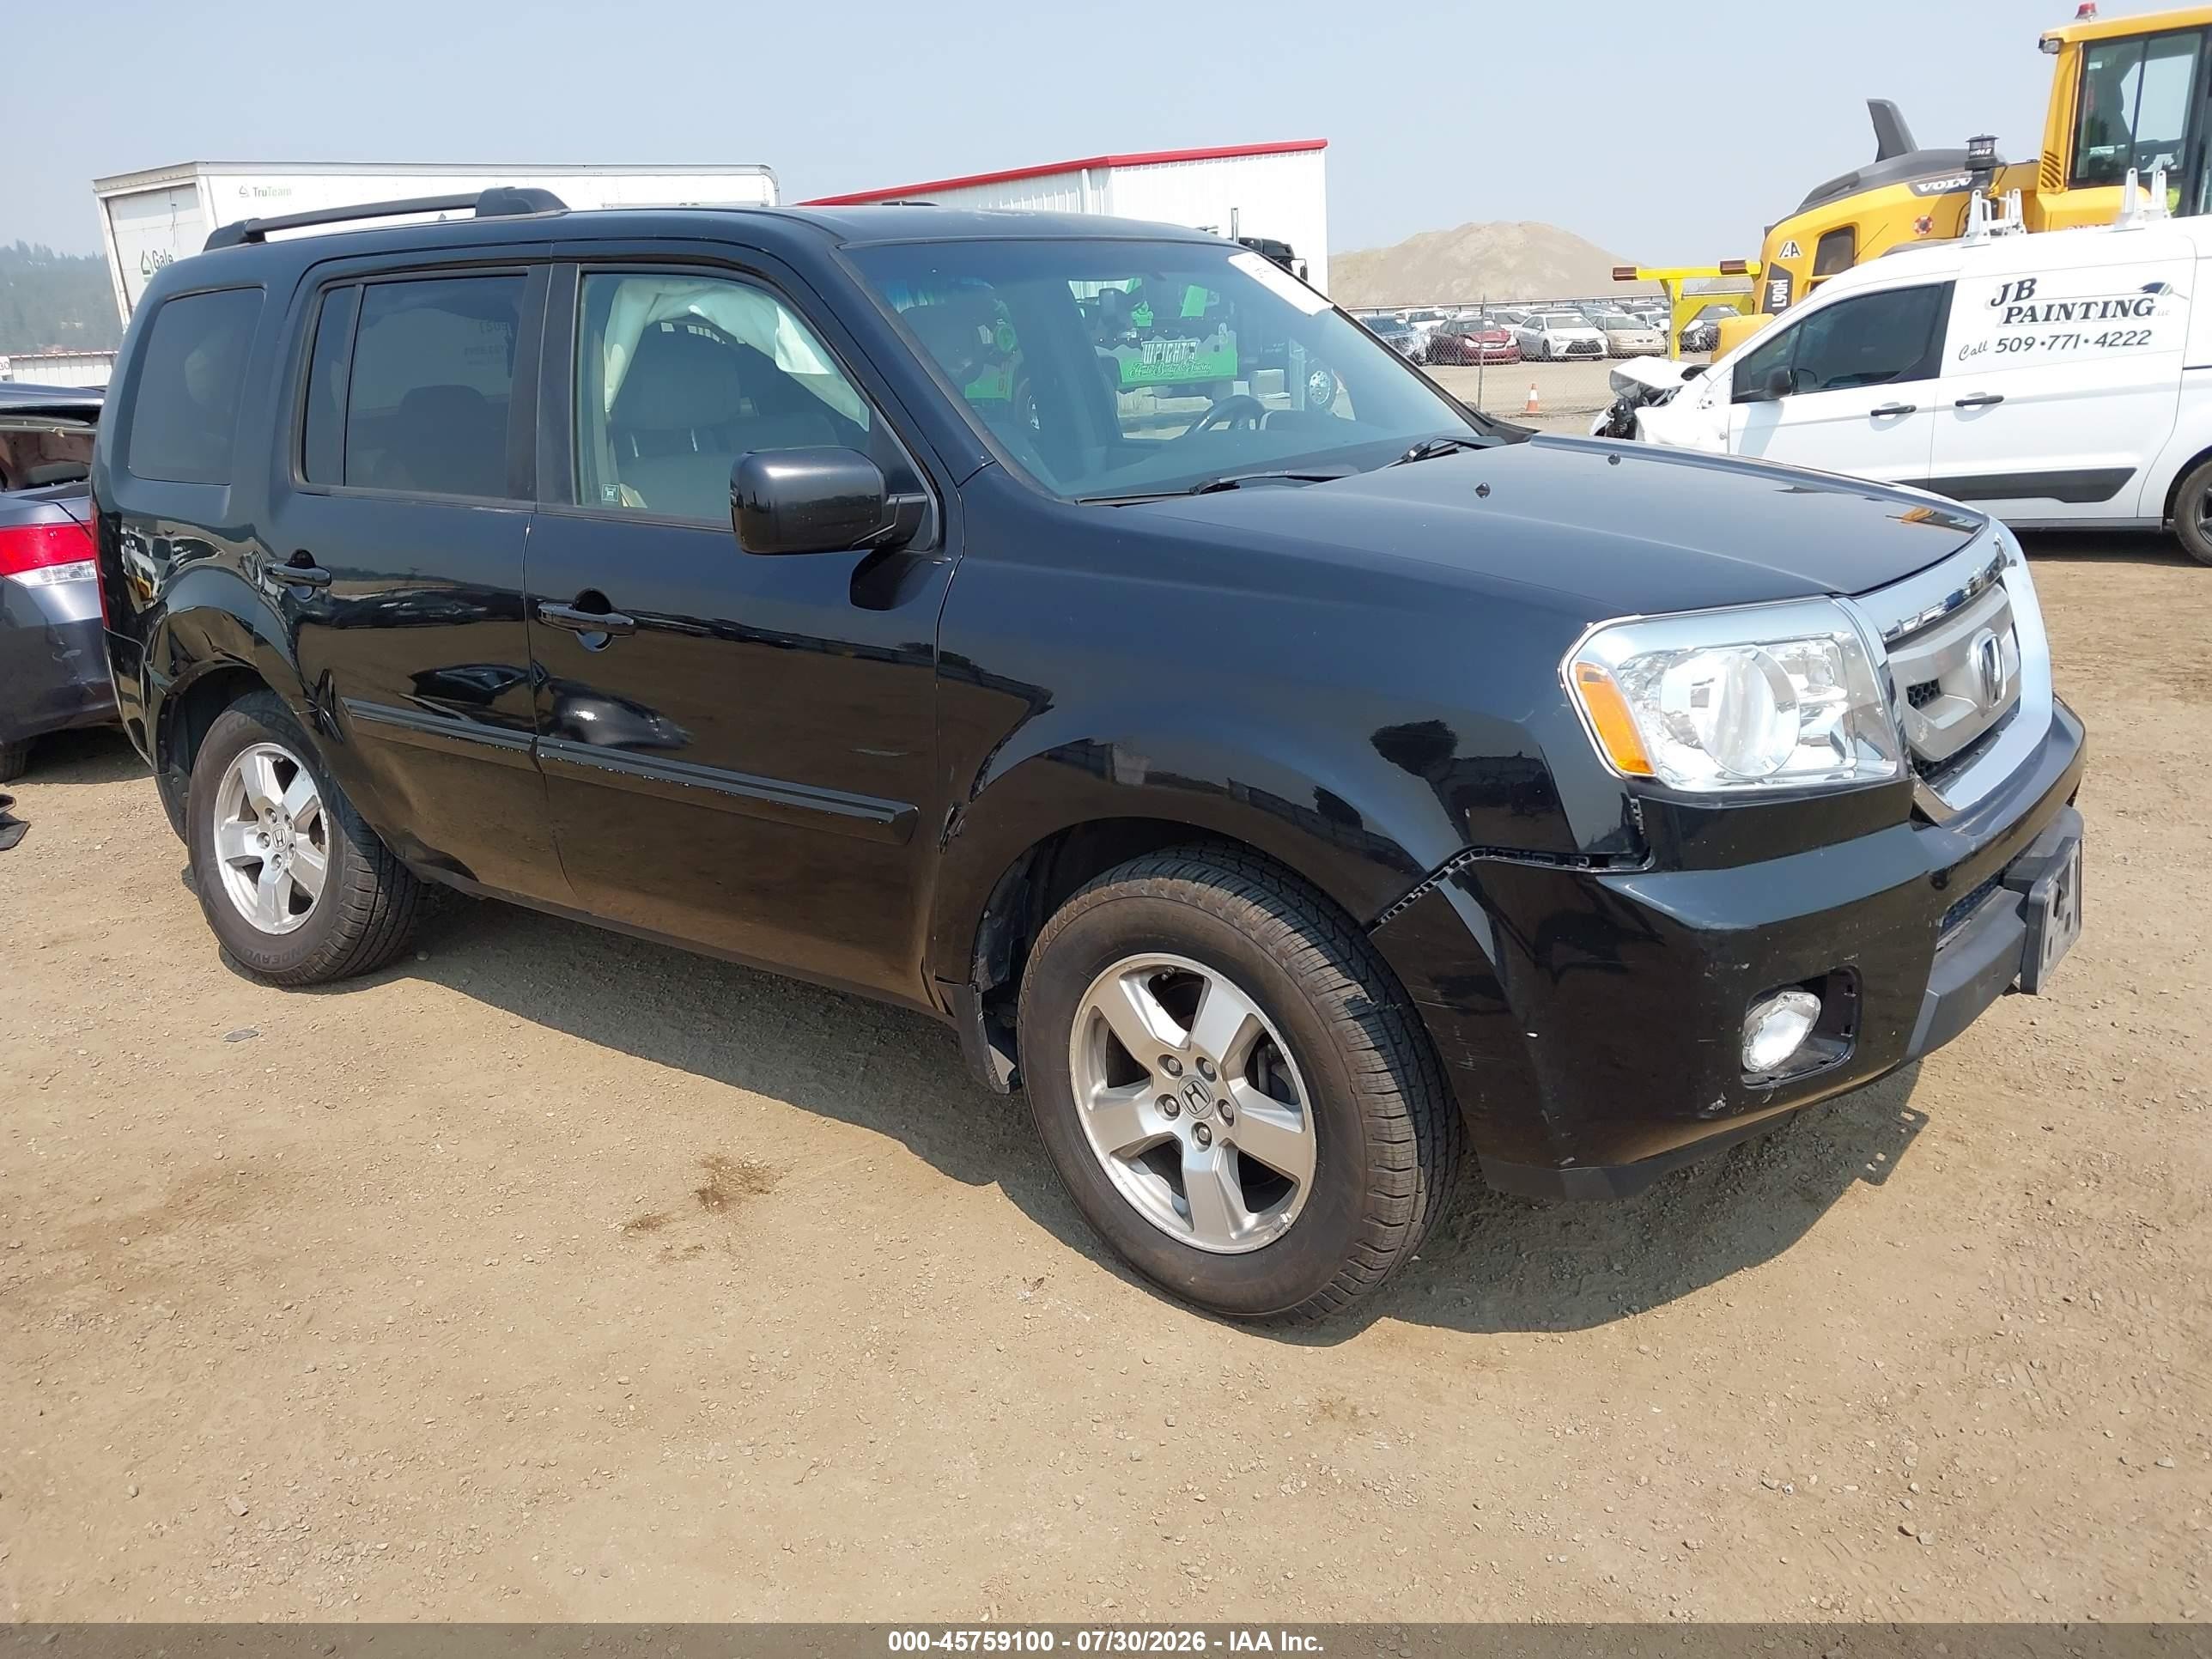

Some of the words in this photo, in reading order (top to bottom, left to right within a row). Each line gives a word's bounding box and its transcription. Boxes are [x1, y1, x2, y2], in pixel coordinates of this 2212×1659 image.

[253, 186, 292, 197] TruTeam
[1917, 177, 1973, 192] VOLV
[1771, 279, 1788, 307] L90H
[2002, 298, 2156, 325] PAINTING
[1958, 340, 1989, 362] Call
